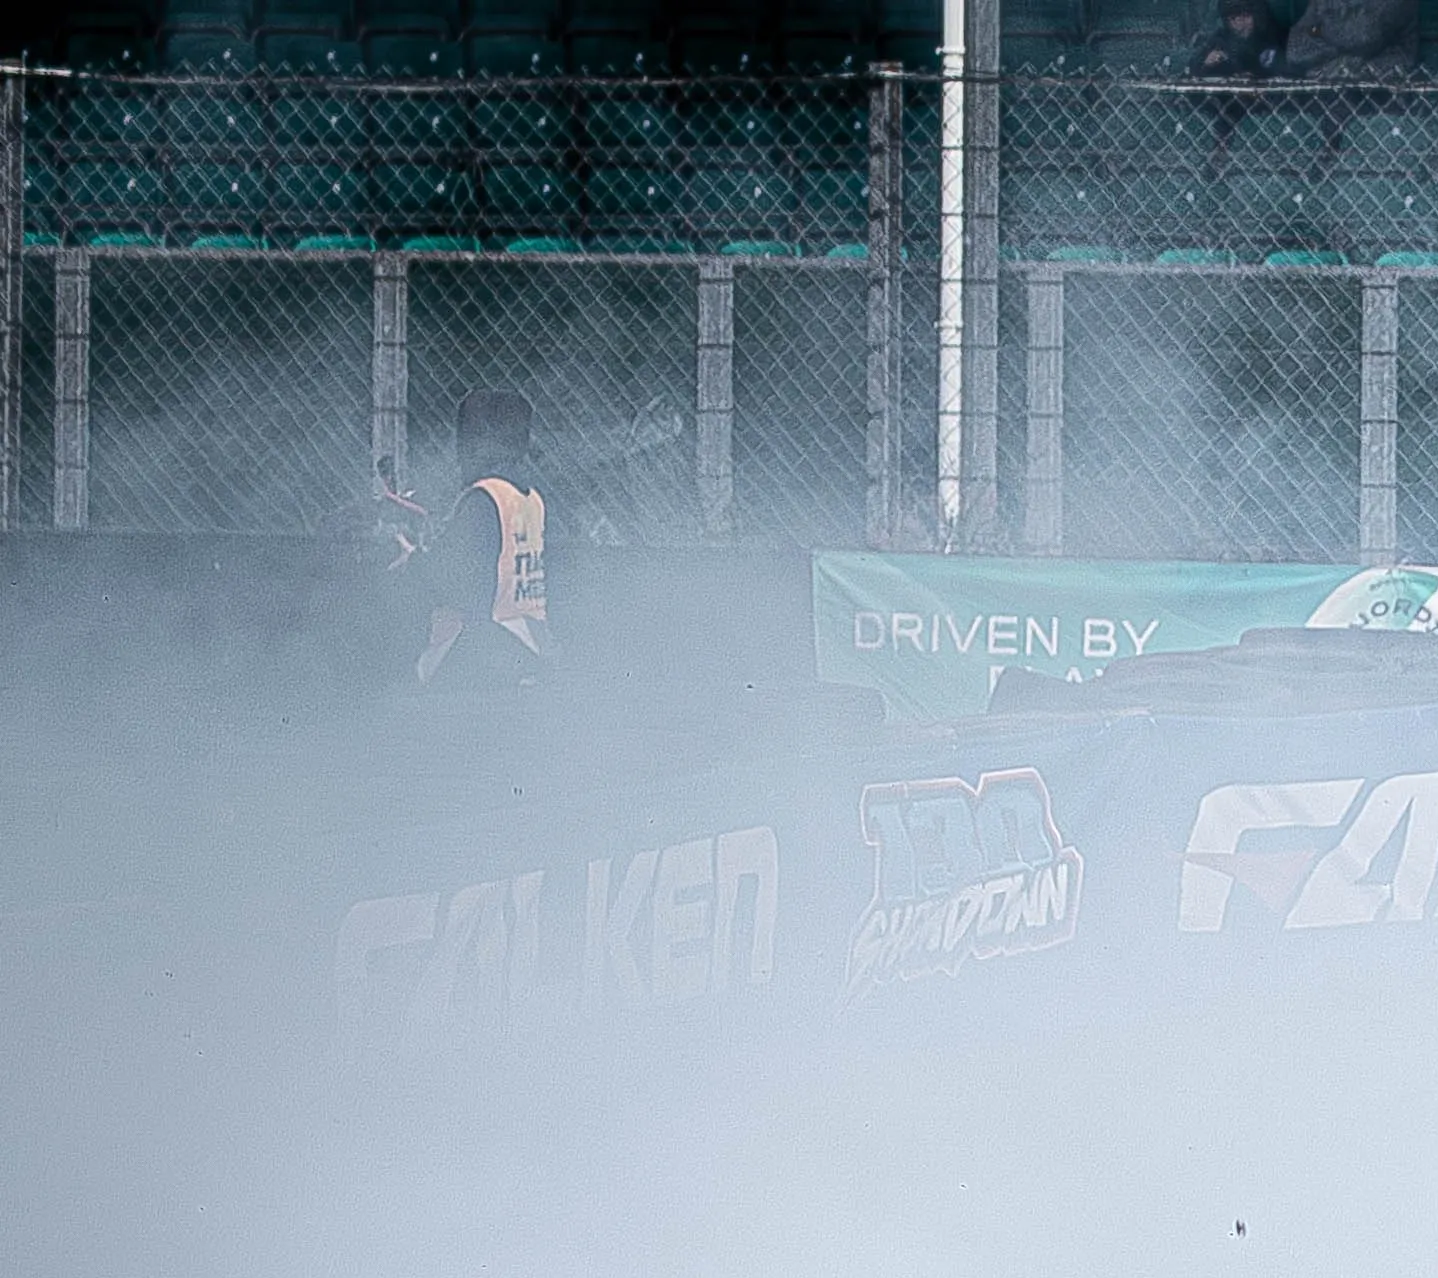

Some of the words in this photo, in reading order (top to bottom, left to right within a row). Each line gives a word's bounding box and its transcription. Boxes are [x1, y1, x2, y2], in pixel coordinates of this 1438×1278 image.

[854, 611, 1058, 656] DRIVEN
[1083, 618, 1159, 656] BY
[336, 826, 779, 1006] FALKEN
